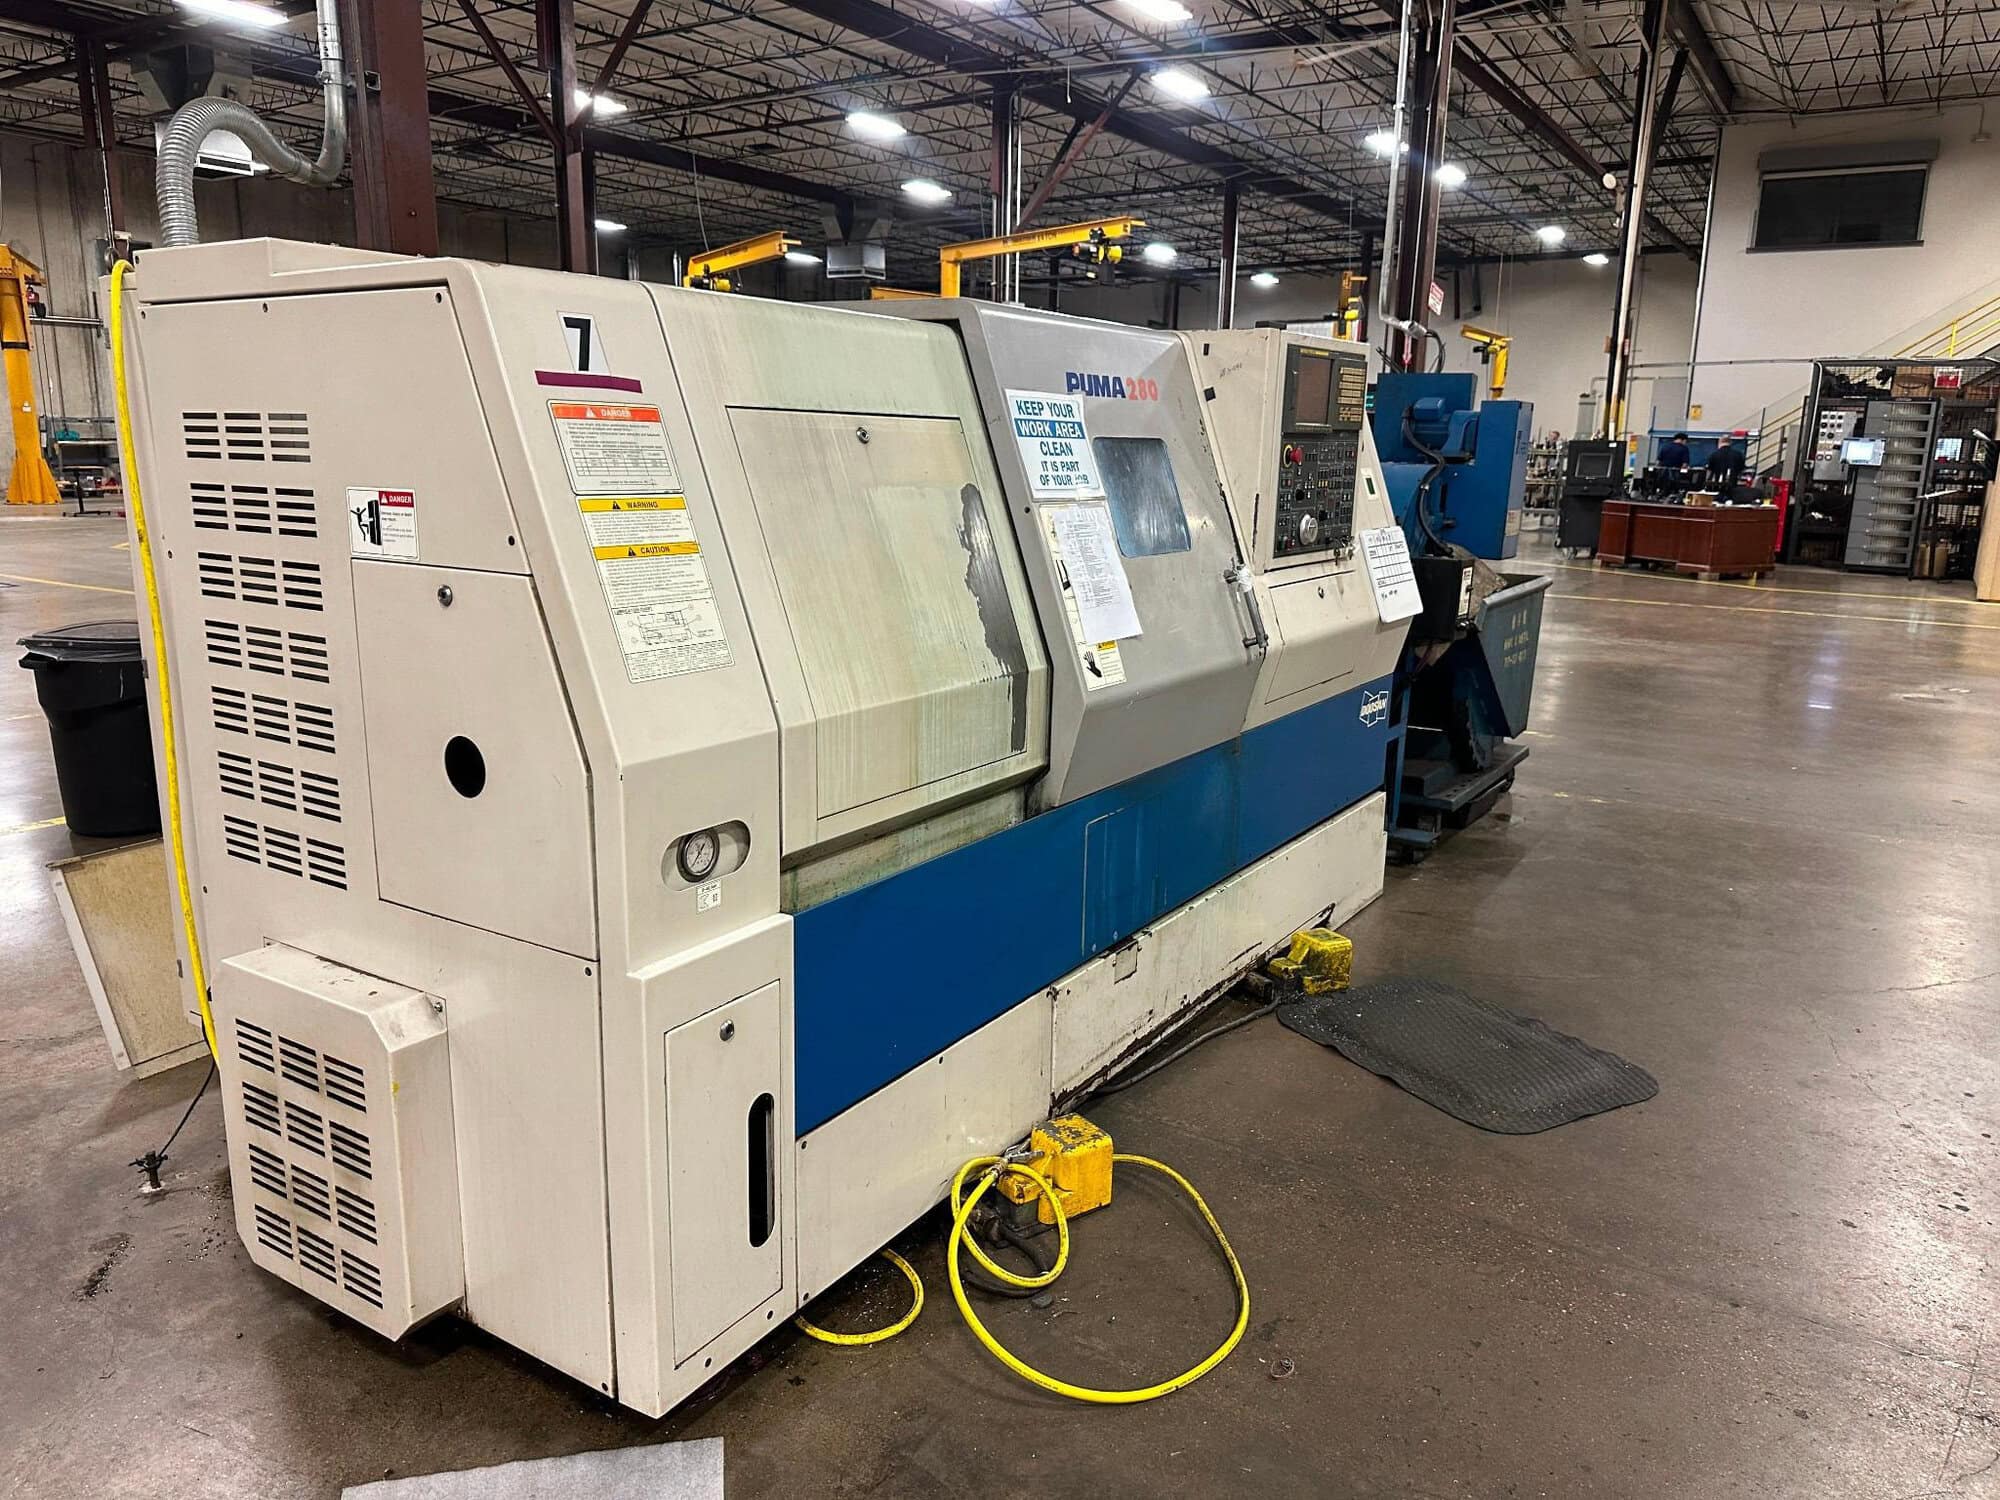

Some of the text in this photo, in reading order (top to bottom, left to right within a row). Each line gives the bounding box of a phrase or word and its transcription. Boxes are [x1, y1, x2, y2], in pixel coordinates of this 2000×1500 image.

[563, 317, 591, 371] 7
[1066, 372, 1158, 401] PUMA 280
[601, 408, 632, 418] DANGER
[1016, 400, 1074, 418] KEEP YOUR
[1018, 420, 1083, 438] WORK AREA
[1040, 441, 1074, 456] CLEAN
[1041, 461, 1080, 472] IT IS PART
[1039, 474, 1050, 486] OF
[1051, 474, 1073, 486] YOUR
[388, 495, 412, 504] DANGER
[626, 501, 659, 509] WARNING
[640, 545, 670, 554] CAUTION
